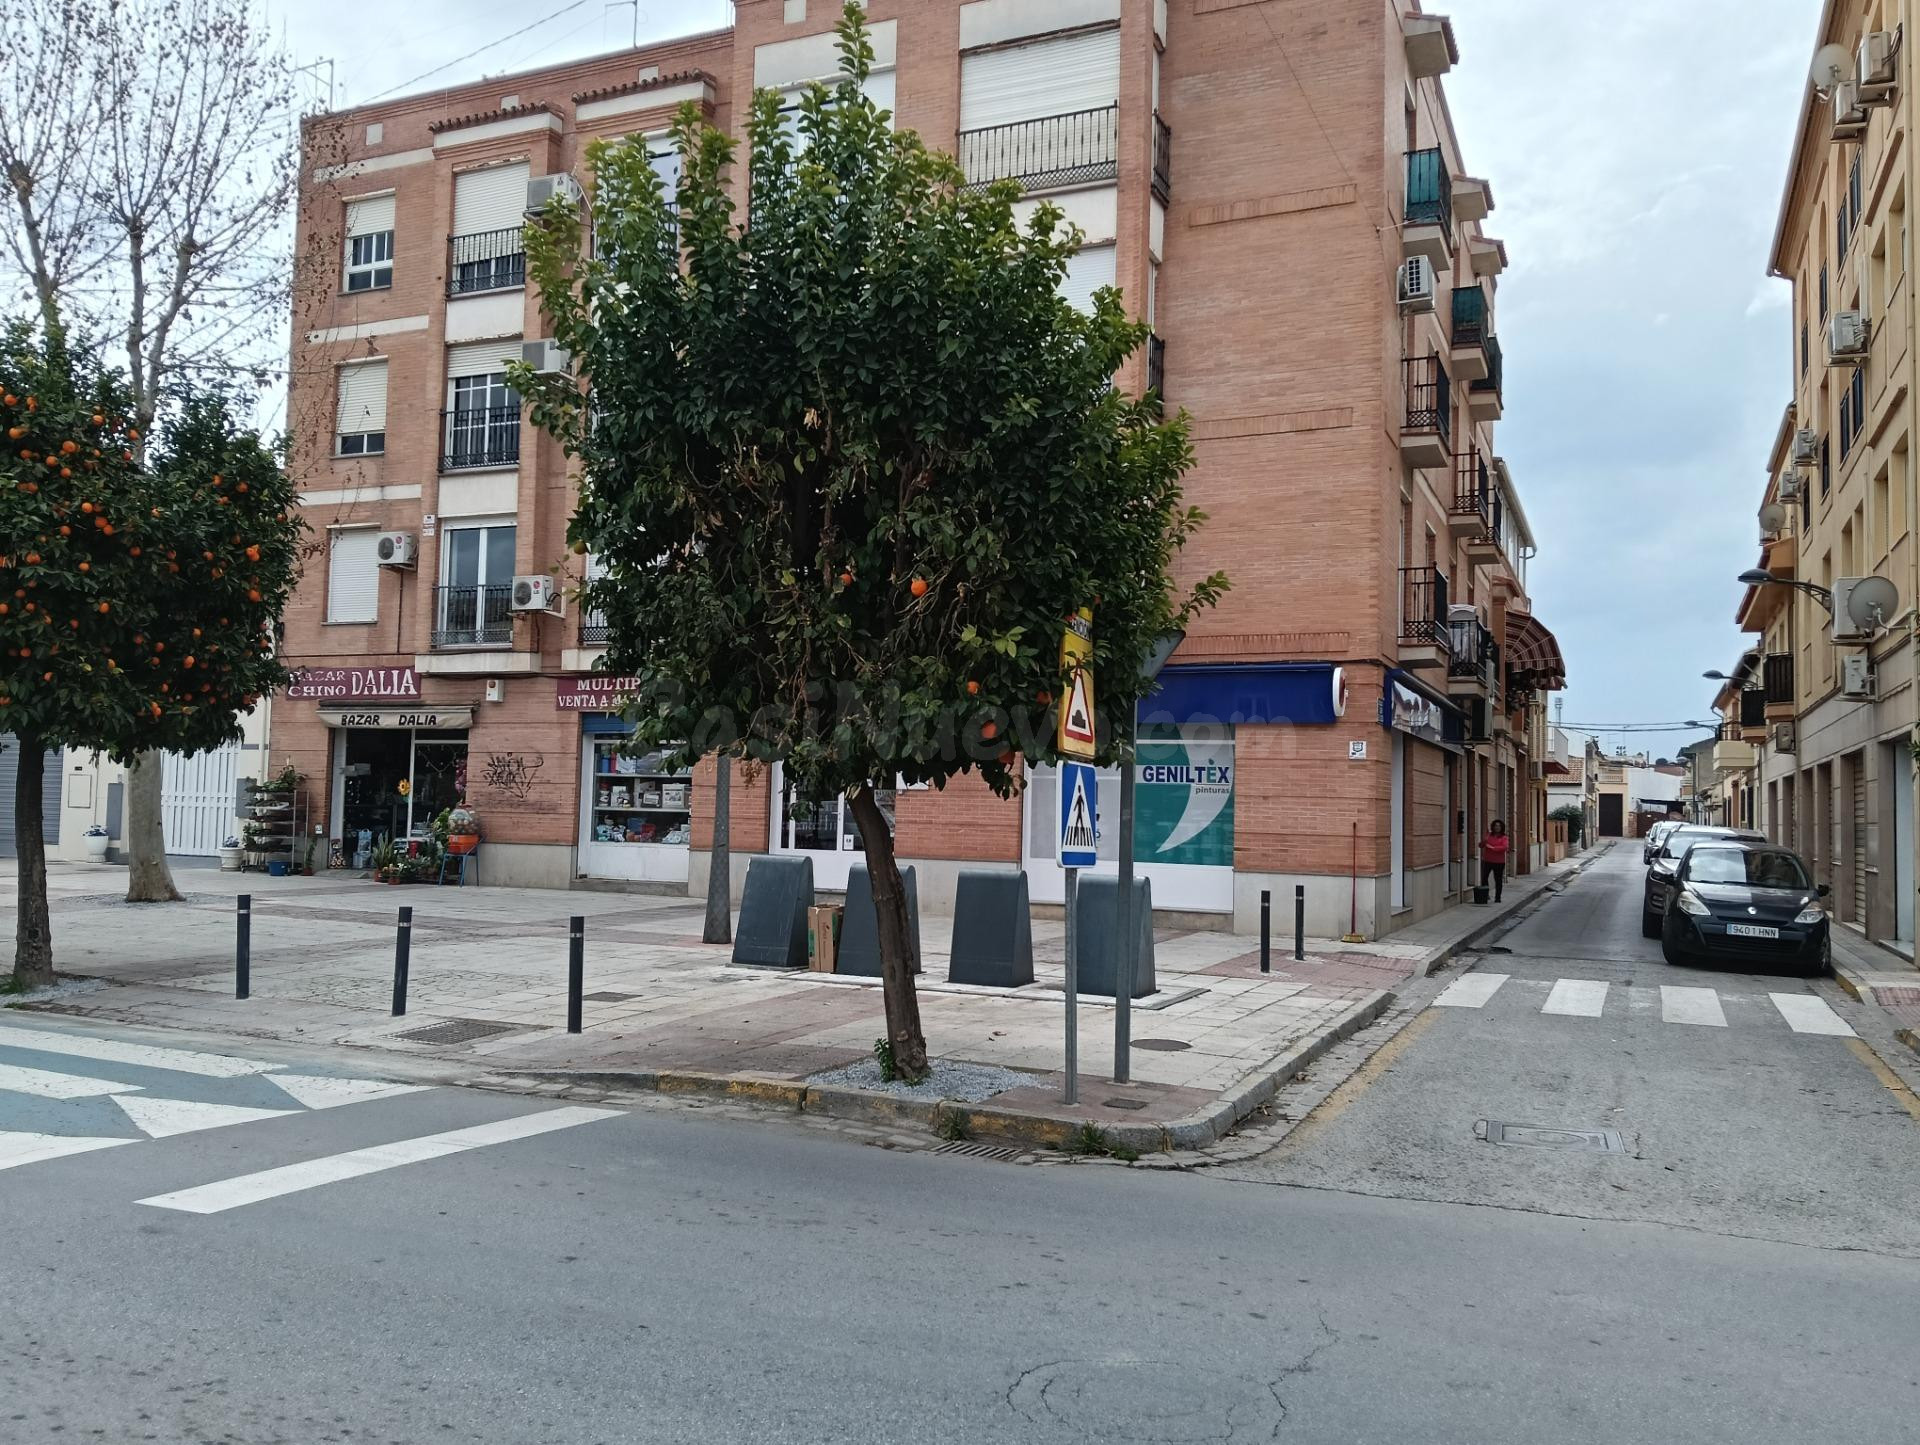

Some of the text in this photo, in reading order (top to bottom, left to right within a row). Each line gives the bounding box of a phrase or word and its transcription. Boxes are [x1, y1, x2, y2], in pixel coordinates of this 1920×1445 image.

[351, 669, 418, 695] DALIA
[287, 685, 346, 697] CHINO
[558, 694, 597, 707] VENTA
[600, 695, 608, 707] A
[341, 714, 437, 726] BAZAR DALIA
[1142, 765, 1230, 783] GENILTEX
[1195, 786, 1230, 795] pinturas
[1733, 925, 1756, 935] 9401
